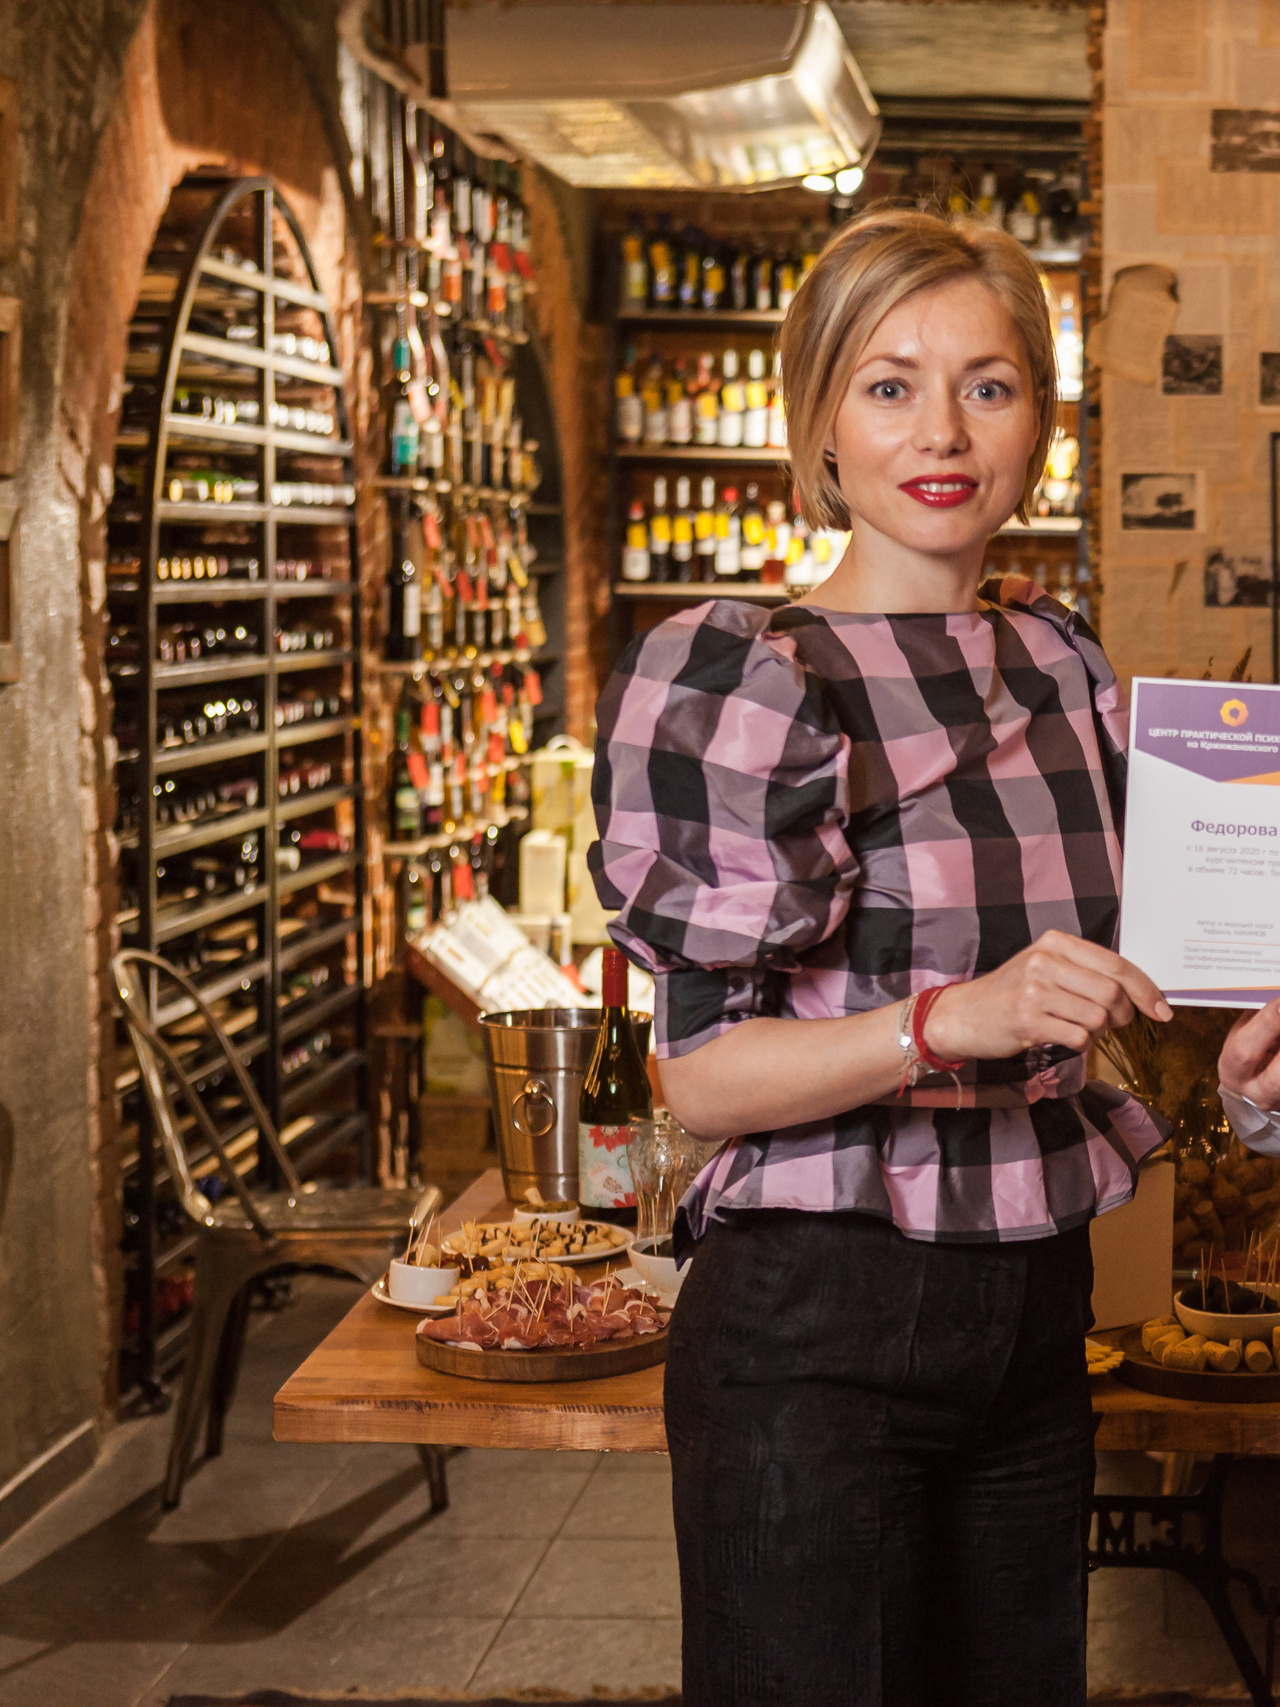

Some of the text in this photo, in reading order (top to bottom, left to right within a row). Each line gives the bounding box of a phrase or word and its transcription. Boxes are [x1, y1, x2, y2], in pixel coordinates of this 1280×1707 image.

[1148, 728, 1180, 738] ЦЕНТР
[1180, 729, 1253, 742] ПРАКТИЧЕСКОЙ
[1186, 741, 1199, 749] на
[1190, 819, 1278, 838] Федорова
